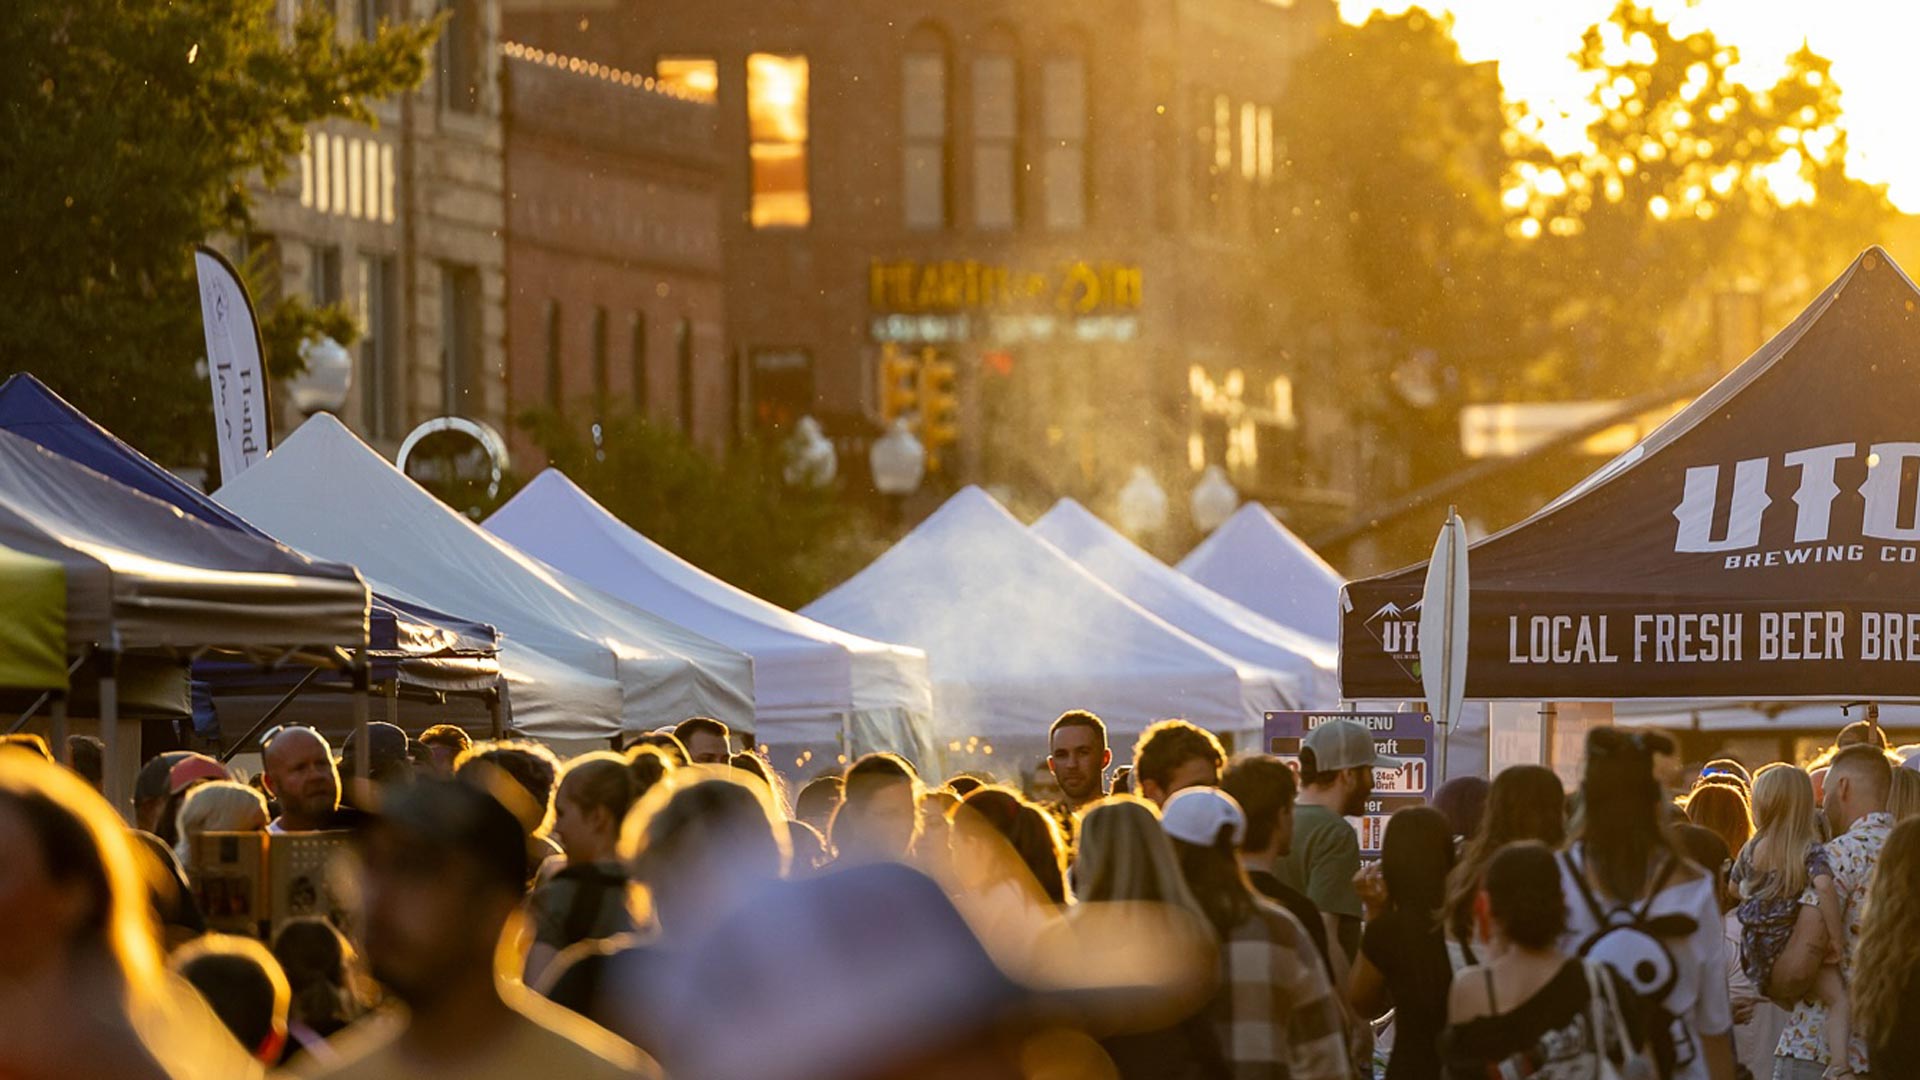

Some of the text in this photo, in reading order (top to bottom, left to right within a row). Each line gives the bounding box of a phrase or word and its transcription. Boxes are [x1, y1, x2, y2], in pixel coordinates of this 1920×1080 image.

[1724, 544, 1864, 569] BREWING
[1382, 621, 1420, 652] UT
[1508, 615, 1619, 663] LOCAL
[1633, 613, 1743, 662] FRESH
[1759, 611, 1845, 661] BEER
[1374, 739, 1398, 754] raft
